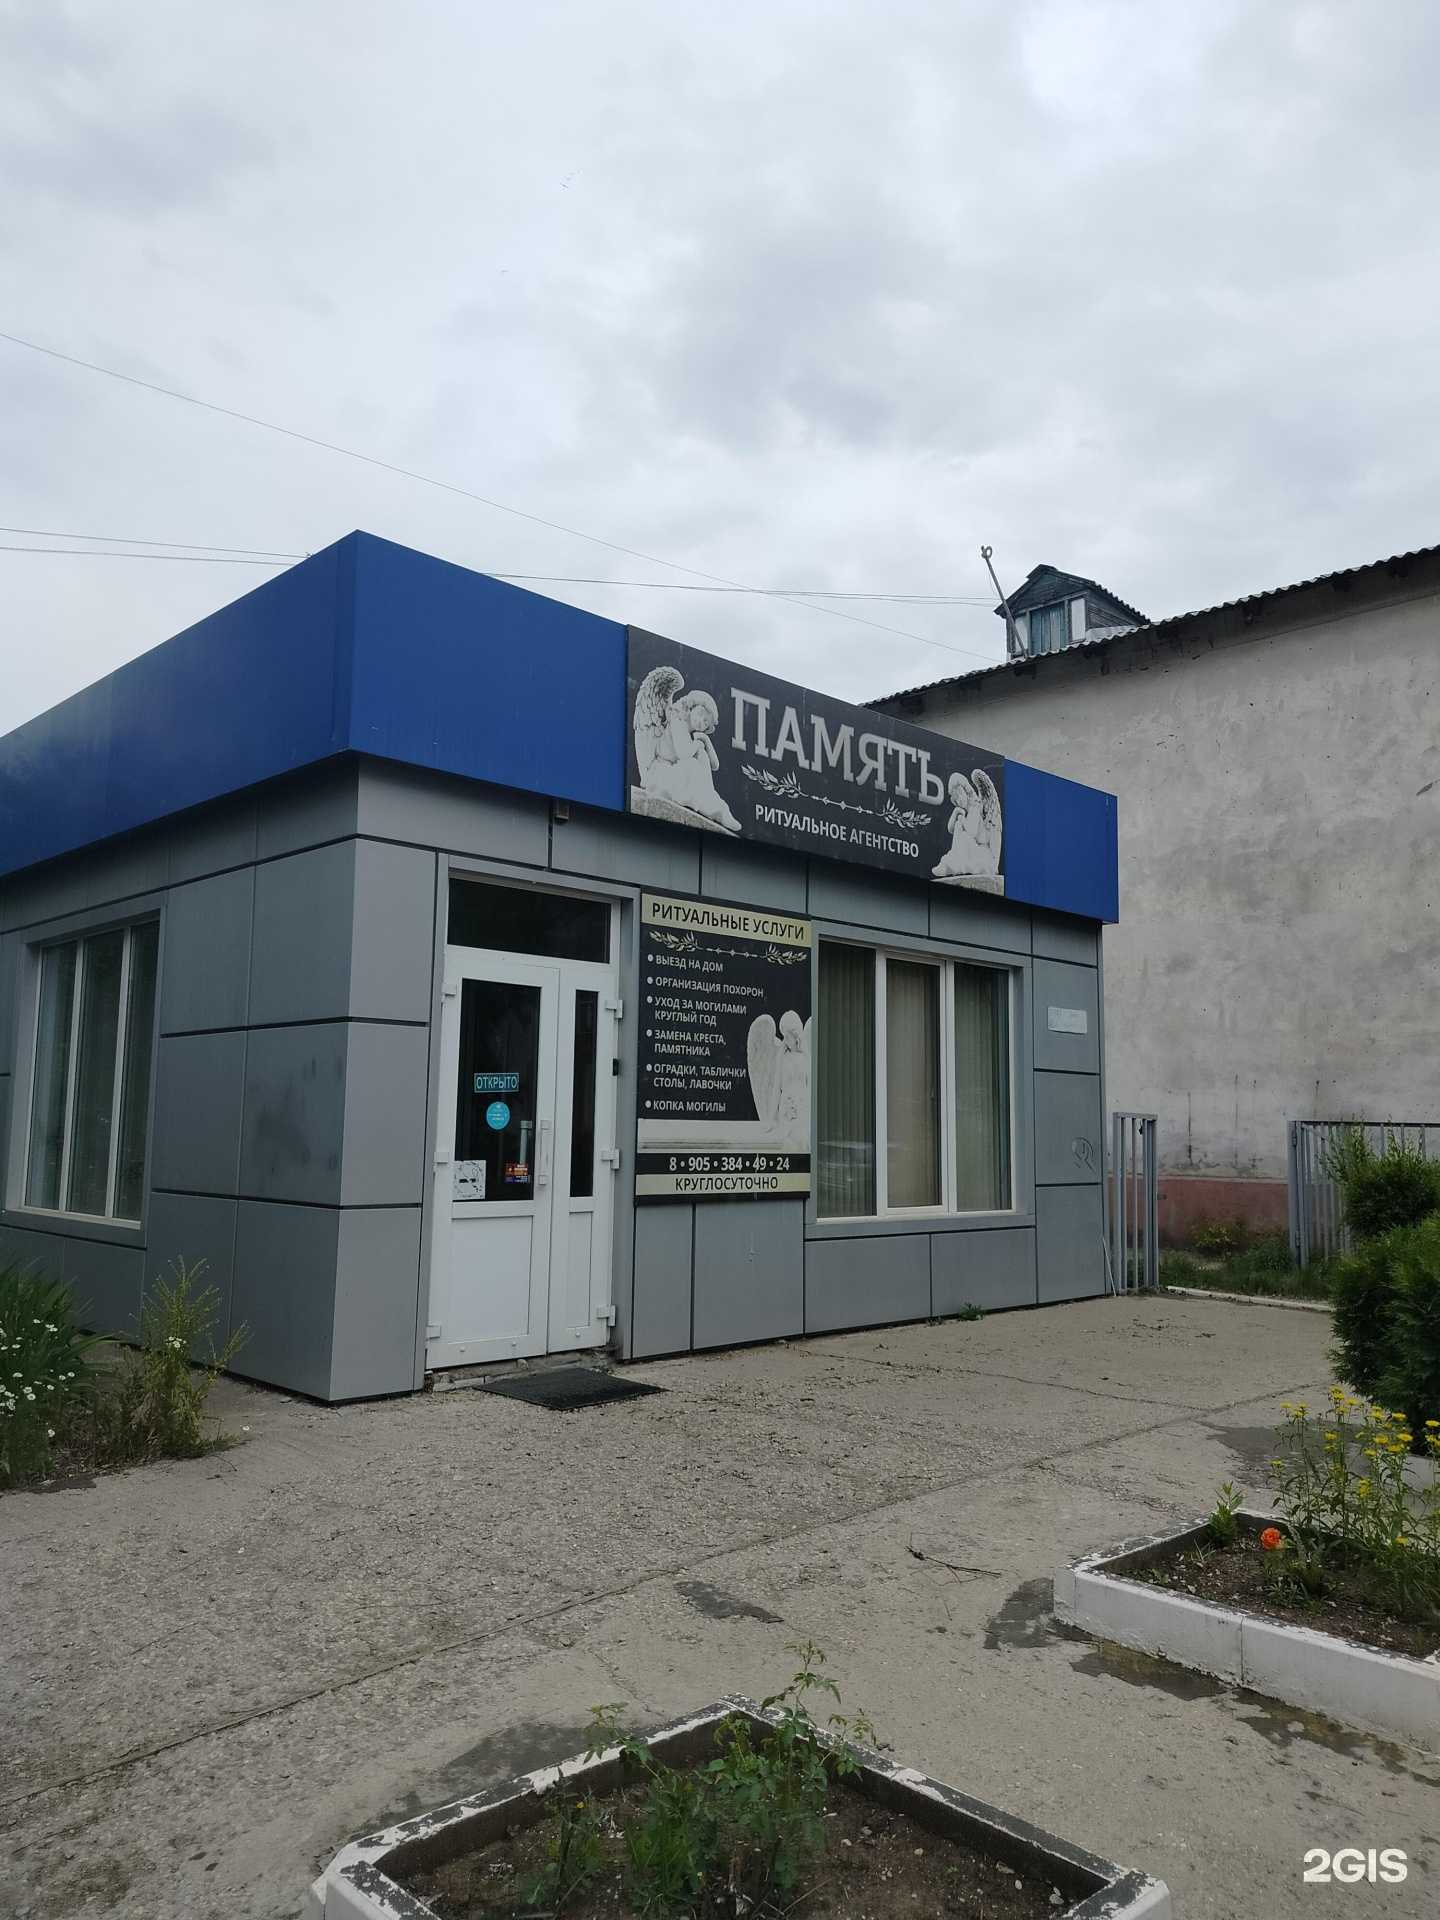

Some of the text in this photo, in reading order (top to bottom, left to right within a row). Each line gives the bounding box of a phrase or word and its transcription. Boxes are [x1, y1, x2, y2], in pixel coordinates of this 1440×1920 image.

[730, 687, 945, 806] ПАМЯТЬ
[755, 803, 920, 858] РИТУАЛЬНОЕ АГЕНТСТВО
[652, 902, 805, 940] РИТУАЛЬНЫЕ УСЛУГИ
[655, 954, 724, 972] ВЫЕЗД НА ДОМ
[655, 976, 764, 997] ОРГАНИЗАЦИЯ ПОХОРОН
[655, 996, 747, 1014] УХОД ЗА МОГИЛАМИ
[655, 1010, 717, 1027] КРУГЛЫЙ ГОД
[655, 1029, 727, 1046] ЗАМЕНА КРЕСТА,
[654, 1044, 711, 1057] ПАМЯТНИКА
[653, 1063, 698, 1077] ОГРАДКИ,
[476, 1076, 518, 1090] ОТКРЫТО
[653, 1077, 732, 1090] СТОЛЫ, ЛАВОЧКИ
[653, 1101, 726, 1112] КОПКА МОГИЛЫ
[675, 1177, 779, 1191] КРУГЛОСУТОЧНО
